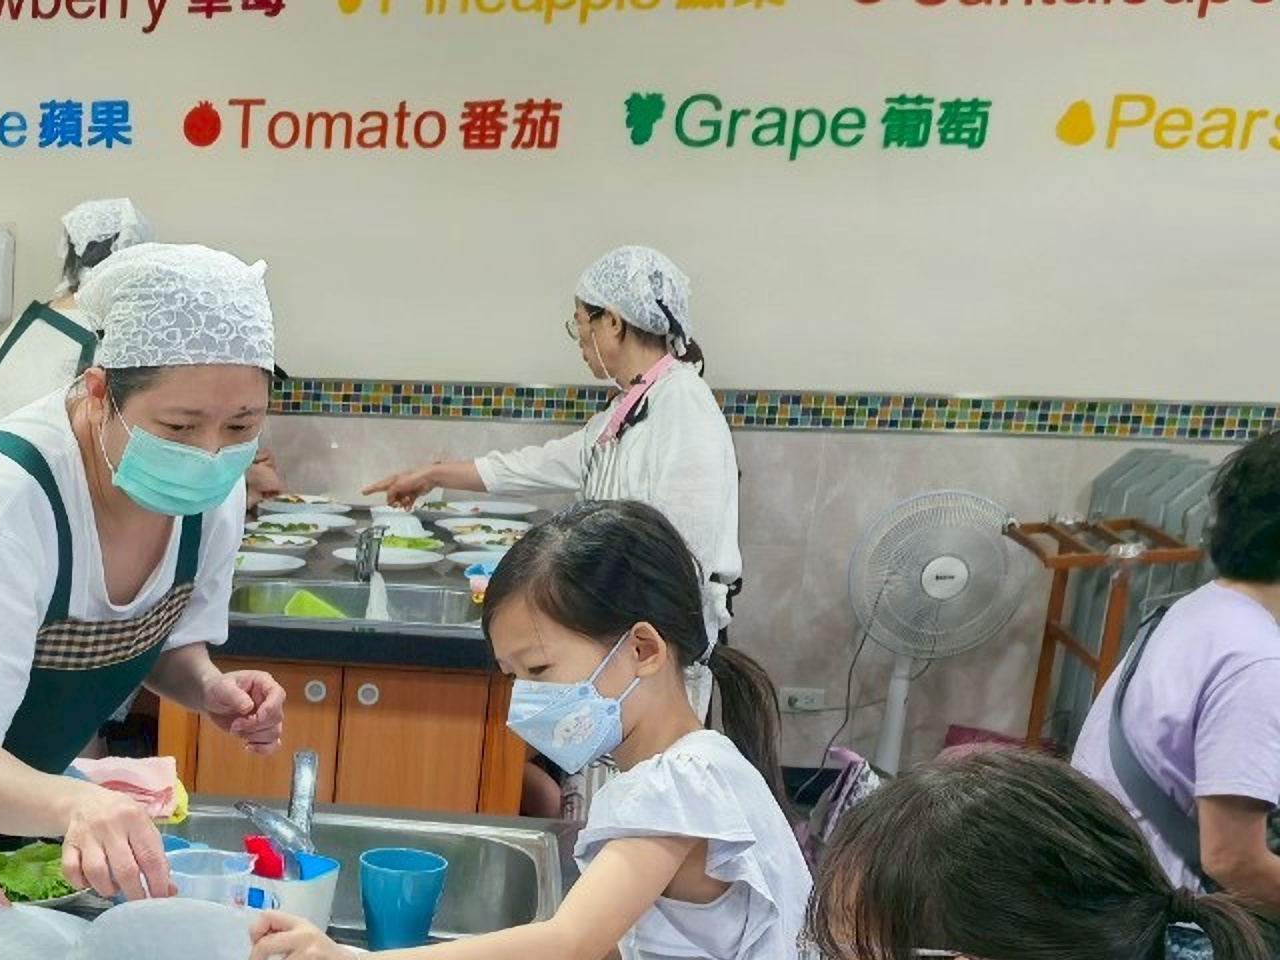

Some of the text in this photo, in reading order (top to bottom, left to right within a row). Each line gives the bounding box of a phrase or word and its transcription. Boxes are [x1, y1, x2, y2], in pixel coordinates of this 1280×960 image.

[38, 99, 132, 149] 蘋果
[228, 97, 562, 150] Tomato 番茄
[674, 93, 991, 160] Grape 葡萄
